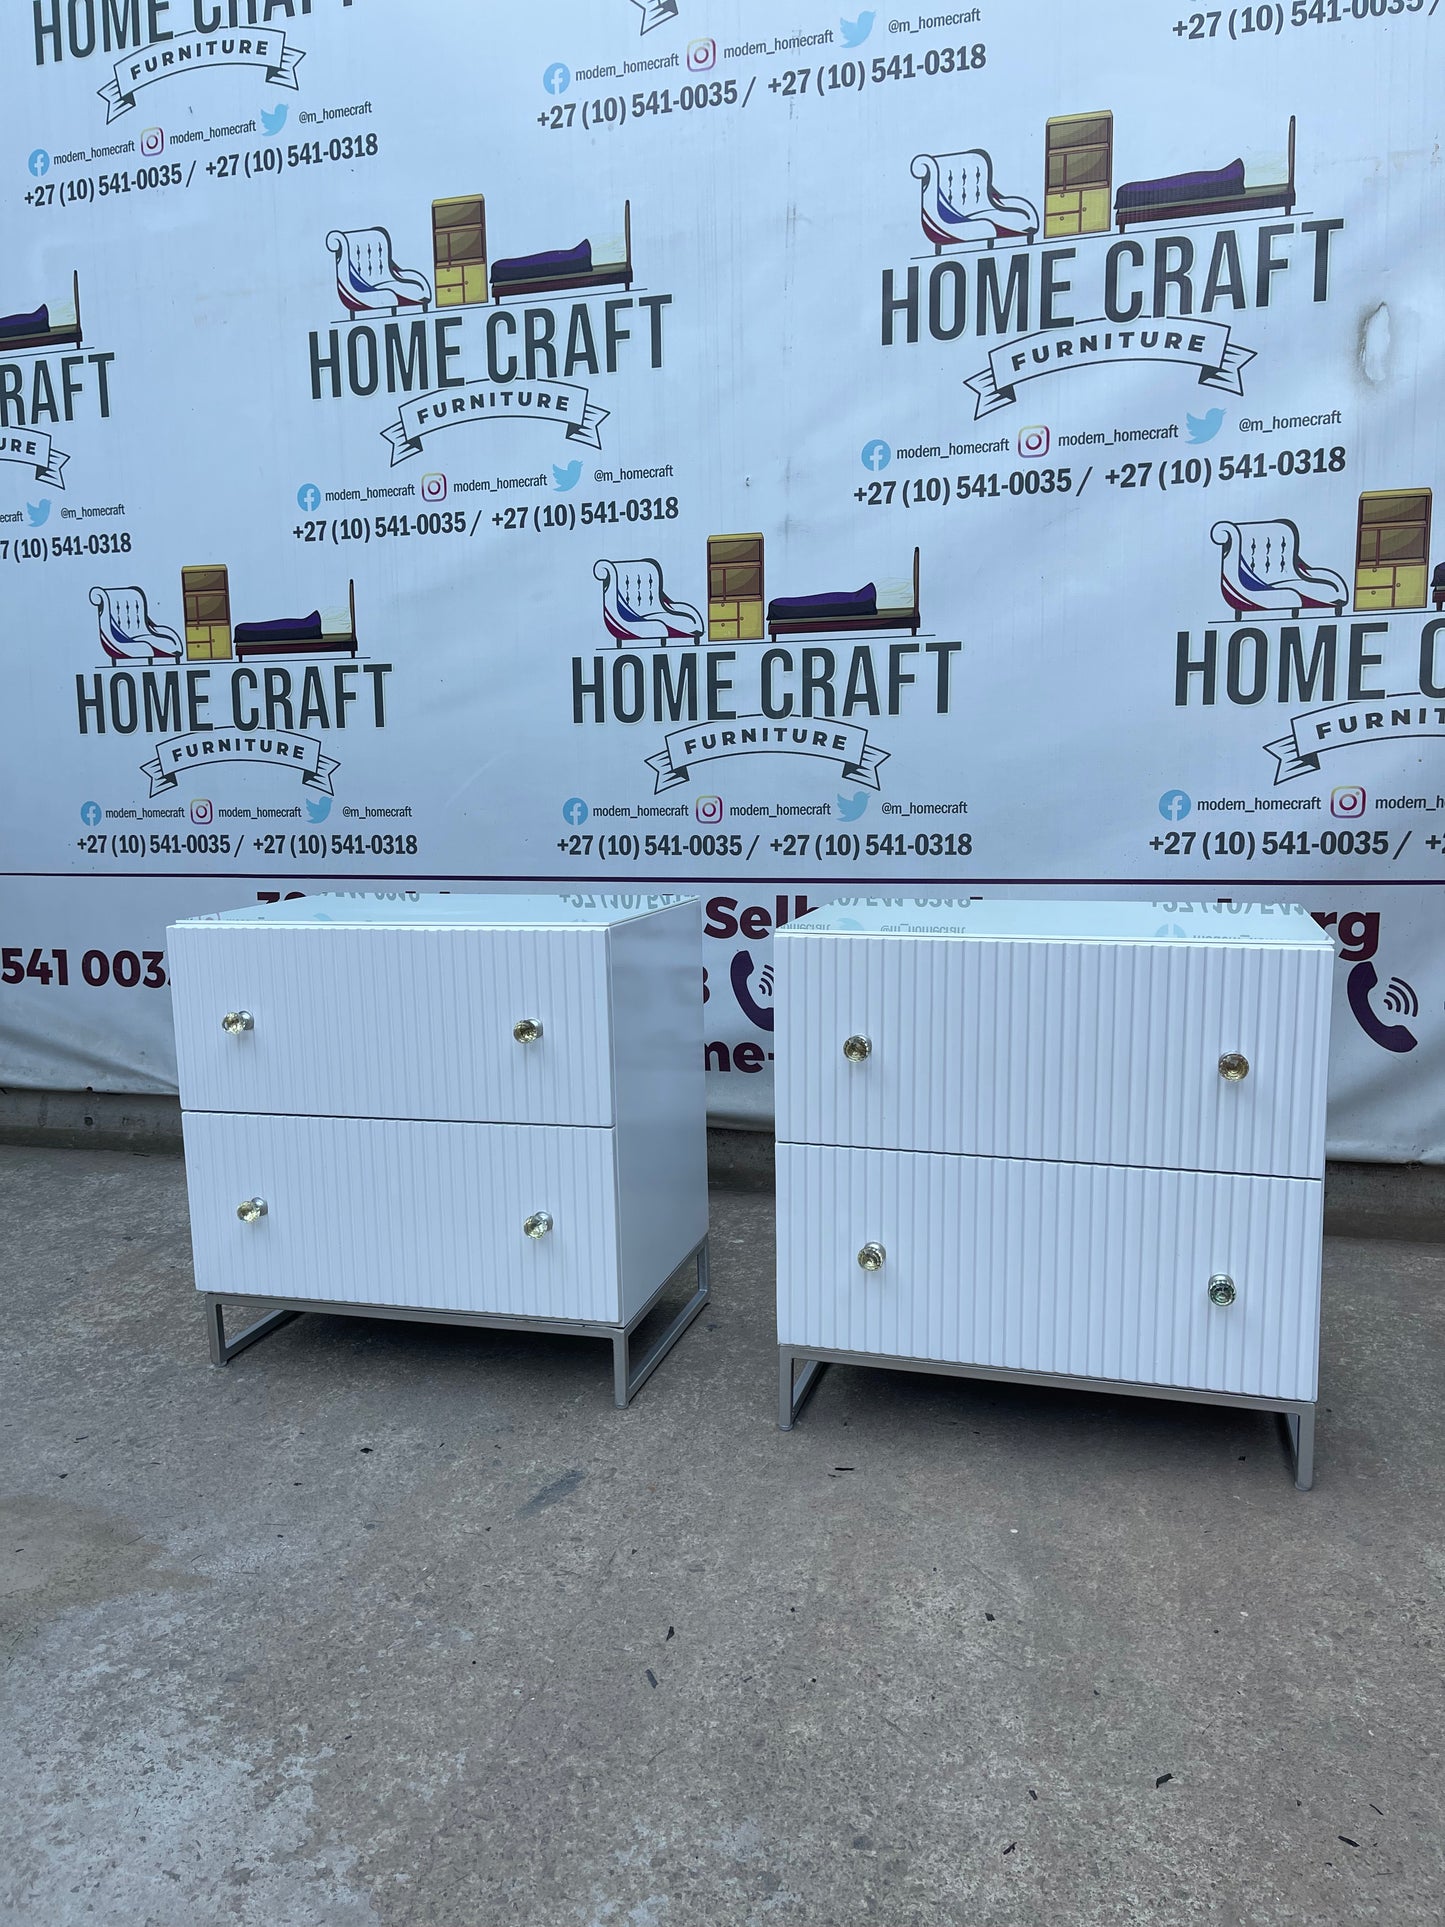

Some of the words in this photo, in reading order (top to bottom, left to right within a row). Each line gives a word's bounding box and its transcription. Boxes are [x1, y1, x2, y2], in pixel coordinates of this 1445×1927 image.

[889, 8, 981, 33] @m_homecraft
[1173, 11, 1221, 39] +27
[1229, 4, 1283, 40] (10)
[131, 40, 268, 80] FURNITURE
[537, 103, 576, 129] +27
[582, 96, 626, 130] (10)
[632, 80, 737, 117] 541-0035
[742, 77, 756, 108] /
[768, 68, 810, 96] +27
[817, 61, 865, 96] (10)
[872, 44, 986, 83] 541-0318
[299, 101, 372, 124] @m_homecraft
[24, 184, 55, 207] +27
[60, 178, 94, 207] (10)
[99, 163, 182, 196] 541-0035
[186, 160, 196, 187] /
[206, 154, 239, 178] +27
[245, 148, 282, 178] (10)
[288, 133, 378, 167] 541-0318
[882, 248, 1076, 346] HOME
[1105, 218, 1344, 323] CRAFT
[309, 317, 465, 399] HOME
[487, 294, 672, 383] CRAFT
[1012, 332, 1205, 371] FURNITURE
[417, 392, 569, 424] FURNITURE
[1239, 410, 1341, 433] @m_homecraft
[594, 464, 673, 483] @m_homecraft
[854, 481, 896, 505] +27
[903, 477, 950, 508] (10)
[956, 468, 1071, 499] 541-0035
[1076, 466, 1093, 497] /
[1105, 462, 1152, 488] +27
[1159, 458, 1211, 490] (10)
[1219, 446, 1345, 480] 541-0318
[61, 504, 125, 520] @m_homecraft
[293, 521, 326, 542] +27
[332, 518, 370, 545] (10)
[375, 511, 466, 537] 541-0035
[470, 510, 482, 536] /
[492, 507, 528, 529] +27
[534, 504, 575, 532] (10)
[581, 497, 678, 524] 541-0318
[14, 538, 47, 563] (10)
[52, 533, 131, 556] 541-0318
[1175, 622, 1388, 706] HOME
[572, 651, 736, 723] HOME
[761, 638, 962, 719] CRAFT
[76, 670, 213, 734] HOME
[232, 664, 392, 731] CRAFT
[172, 739, 304, 762] FURNITURE
[685, 728, 847, 754] FURNITURE
[343, 806, 412, 819] @m_homecraft
[882, 801, 968, 816] @m_homecraft
[77, 835, 107, 853] +27
[112, 835, 145, 857] (10)
[150, 834, 230, 853] 541-0035
[234, 835, 244, 857] /
[254, 835, 285, 853] +27
[291, 835, 326, 858] (10)
[332, 835, 417, 854] 541-0318
[557, 835, 593, 855] +27
[599, 835, 639, 860] (10)
[645, 835, 742, 856] 541-0035
[746, 835, 760, 860] /
[770, 835, 809, 855] +27
[816, 834, 859, 860] (10)
[866, 833, 972, 855] 541-0318
[1150, 832, 1196, 854] +27
[1203, 831, 1255, 860] (10)
[1262, 831, 1388, 855] 541-0035
[1393, 831, 1412, 860] /
[1, 948, 68, 985] 541
[82, 950, 171, 988] 003
